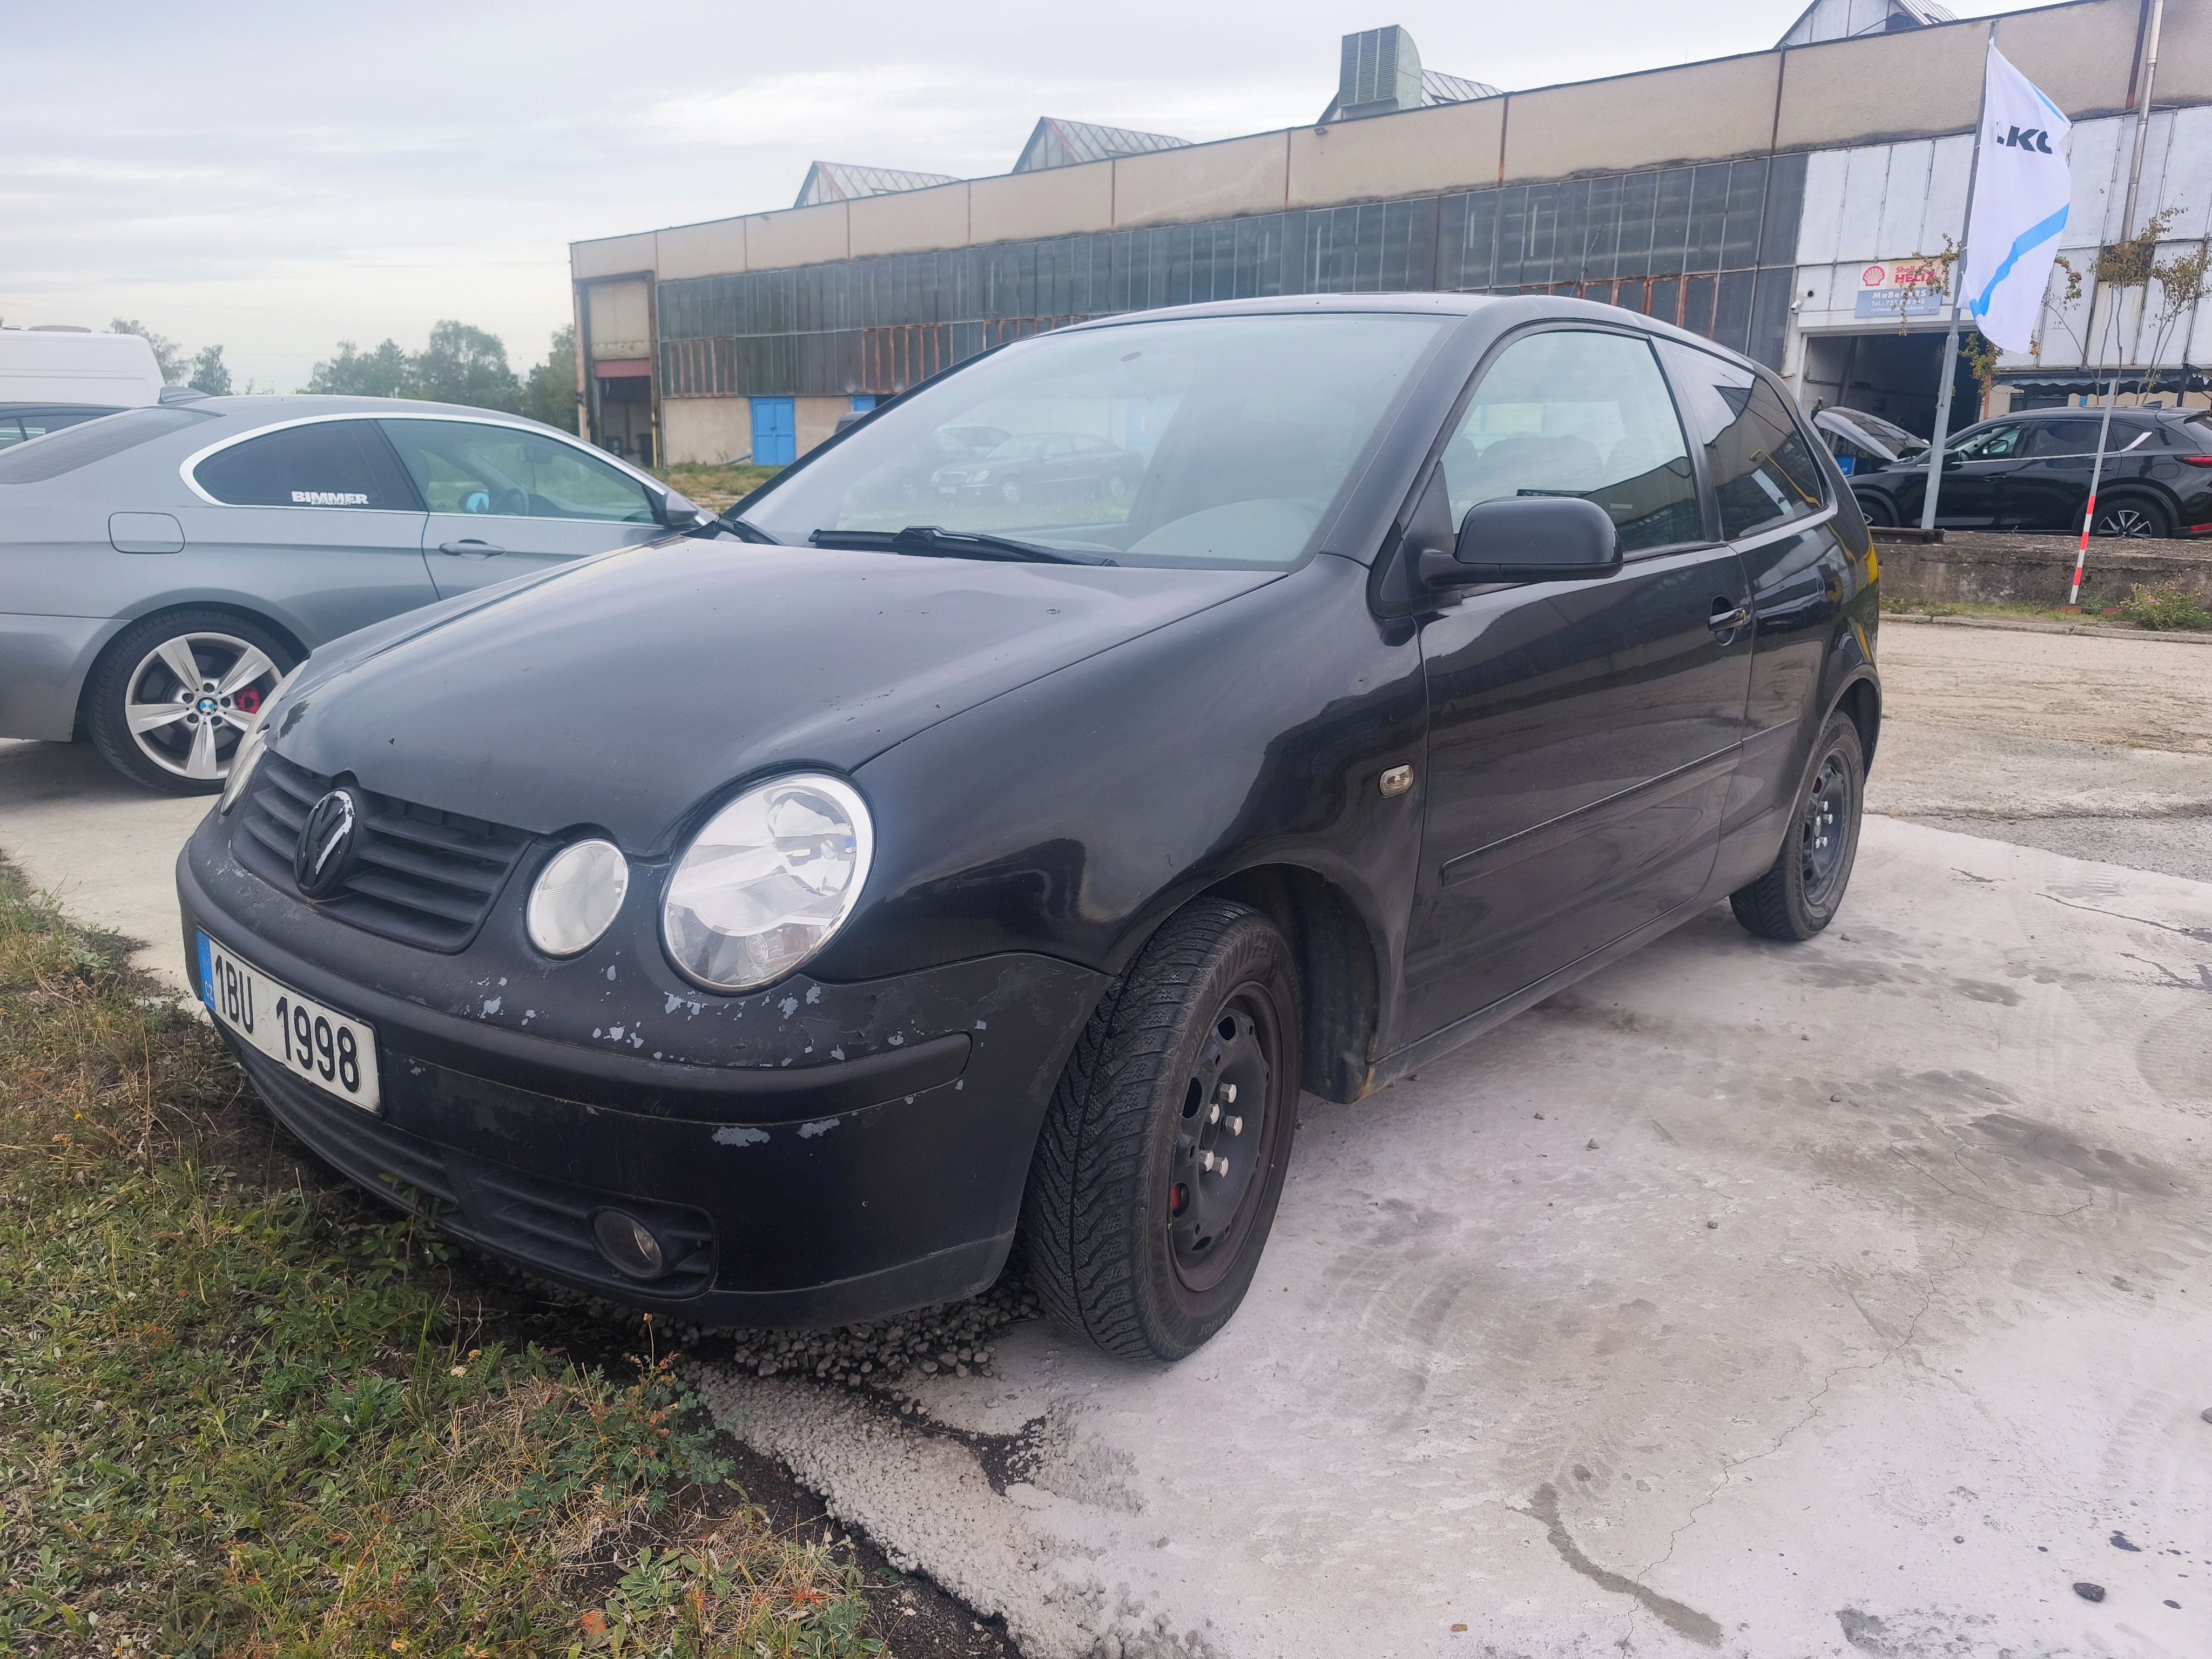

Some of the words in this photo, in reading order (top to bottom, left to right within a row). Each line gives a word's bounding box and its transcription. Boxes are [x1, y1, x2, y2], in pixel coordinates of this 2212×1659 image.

[291, 491, 369, 504] BIMMER
[204, 980, 214, 1001] CZ
[215, 954, 254, 1034] 1BU
[276, 996, 360, 1092] 1998
